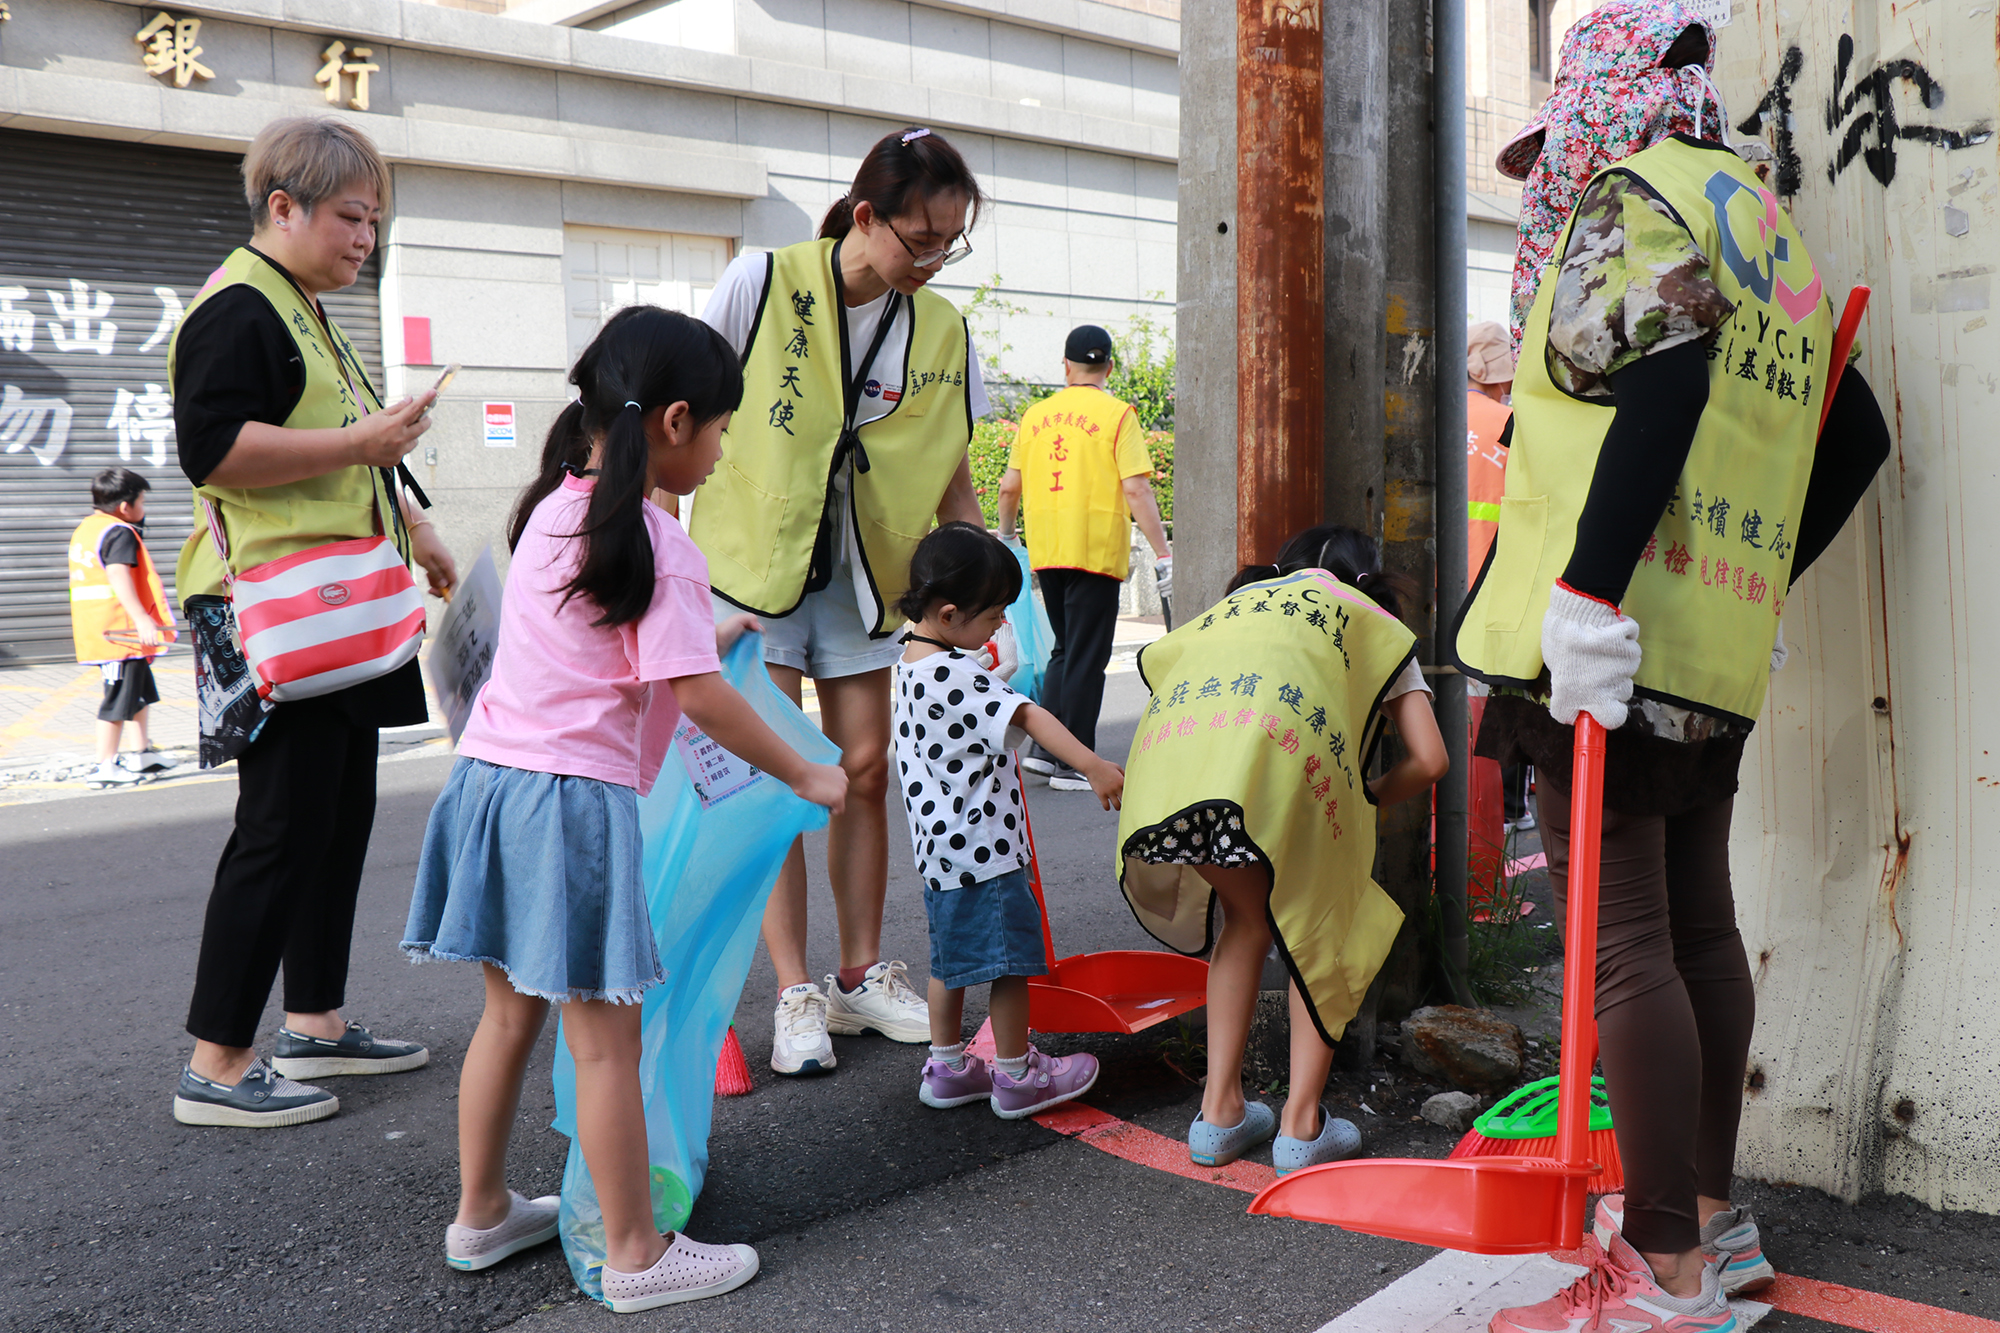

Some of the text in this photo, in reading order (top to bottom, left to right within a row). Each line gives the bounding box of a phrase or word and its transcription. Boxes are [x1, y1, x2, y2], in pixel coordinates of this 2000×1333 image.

[769, 289, 816, 437] 健康天使
[1049, 434, 1069, 492] 志工
[1134, 707, 1343, 841] 期篩檢 規律運動 健康安心
[1278, 682, 1354, 790] 健康放心
[790, 985, 808, 994] FILA
